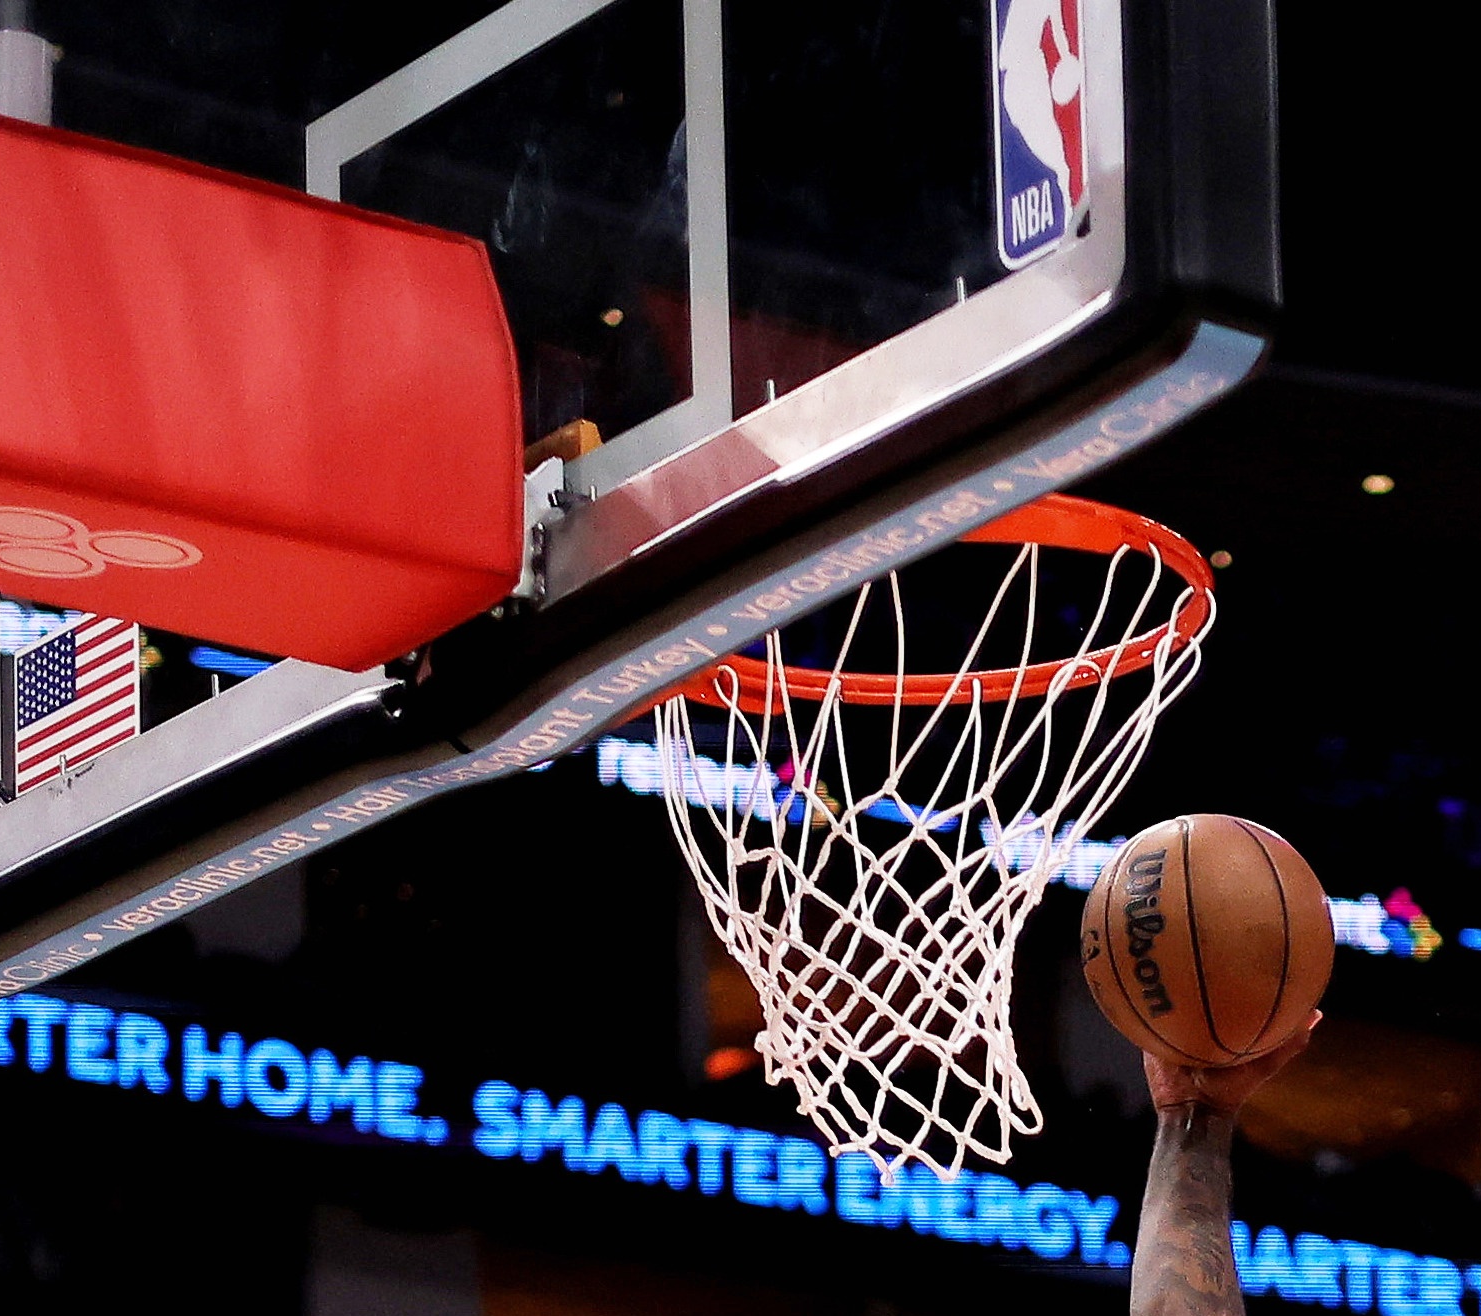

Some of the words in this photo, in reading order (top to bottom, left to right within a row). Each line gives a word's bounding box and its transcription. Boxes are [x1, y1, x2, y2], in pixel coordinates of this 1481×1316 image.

[1011, 178, 1055, 248] NBA
[103, 830, 317, 934] veraclinic.net
[324, 784, 409, 829] Hair
[572, 636, 718, 704] Turkey
[728, 486, 985, 624] veraclinic.net
[1124, 849, 1173, 1017] Wilson
[181, 1023, 450, 1147] HOME.
[471, 1080, 828, 1215] SMARTER
